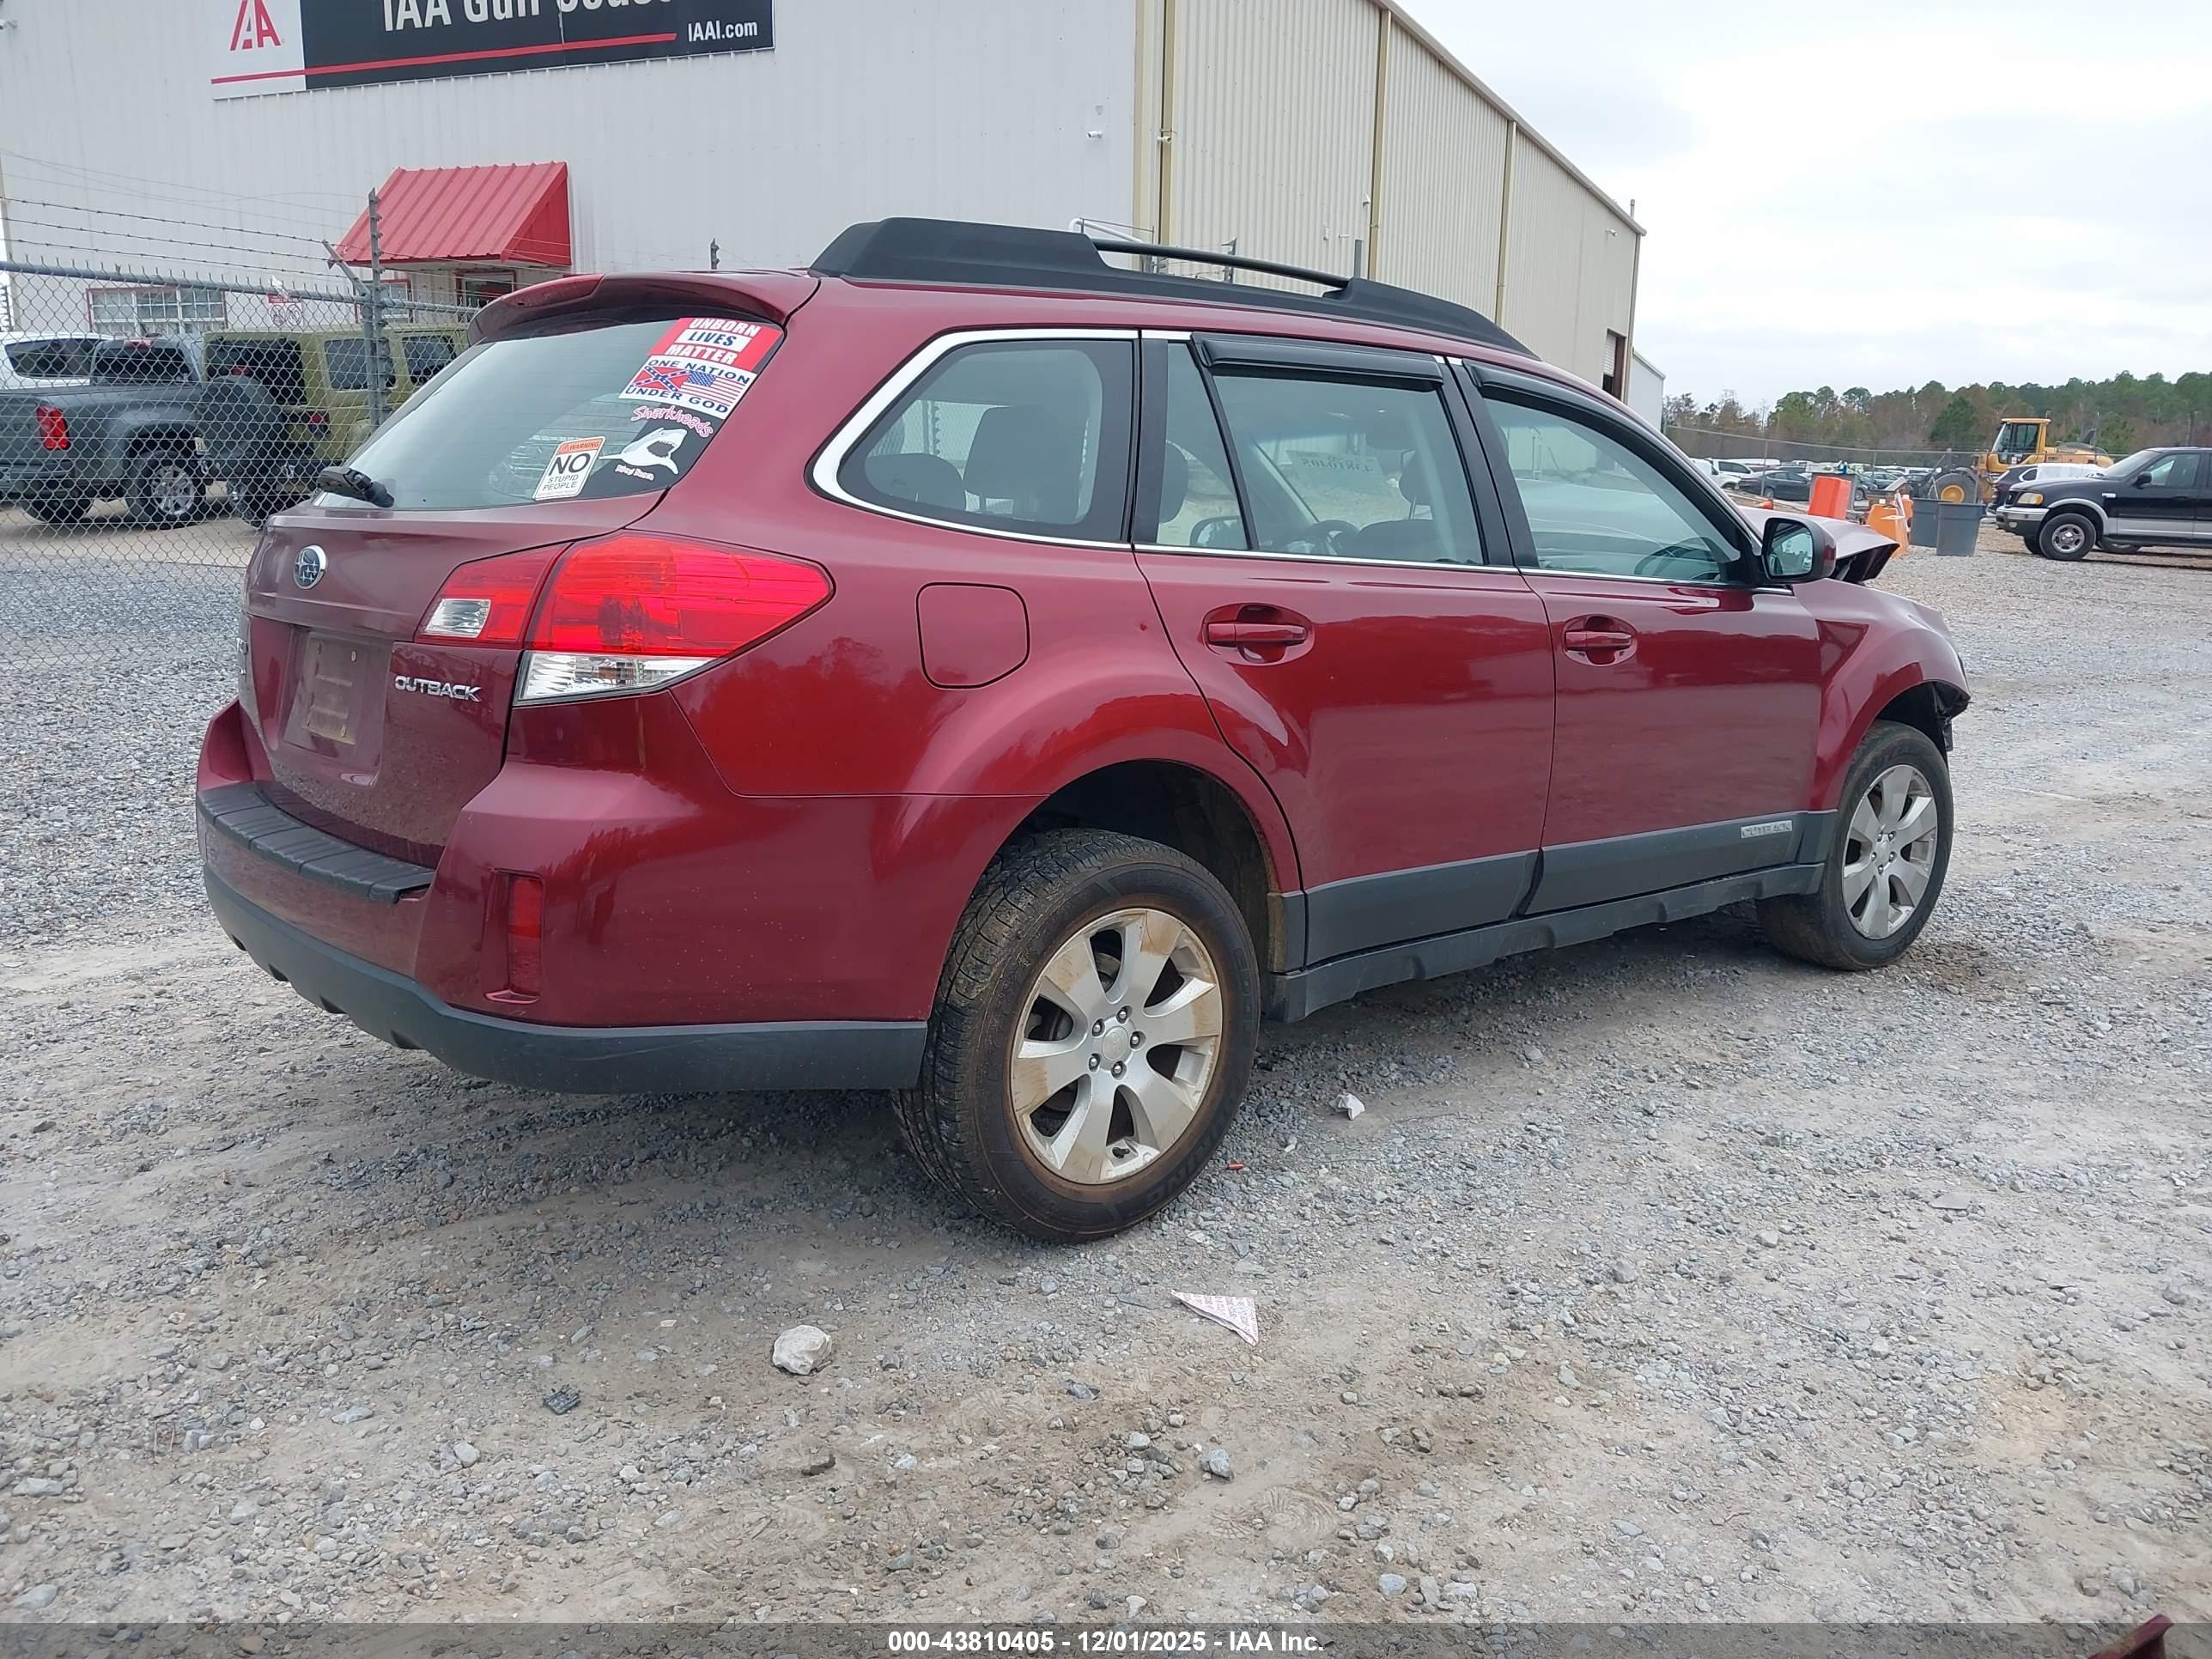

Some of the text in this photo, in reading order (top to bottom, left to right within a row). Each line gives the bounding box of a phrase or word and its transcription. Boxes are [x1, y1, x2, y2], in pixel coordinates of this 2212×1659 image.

[383, 0, 452, 31] IAA
[688, 21, 758, 42] IAAI.com
[689, 318, 762, 337] UNBORN
[688, 331, 737, 346] LIVES
[665, 344, 738, 365] MATTER
[648, 359, 750, 384] ONE NATION
[625, 386, 728, 413] UNDER GOD
[569, 441, 599, 451] WARNING
[548, 453, 591, 476] NO
[543, 481, 577, 491] PEOPLE
[549, 474, 579, 483] STUPID
[395, 675, 482, 702] OUTBACK
